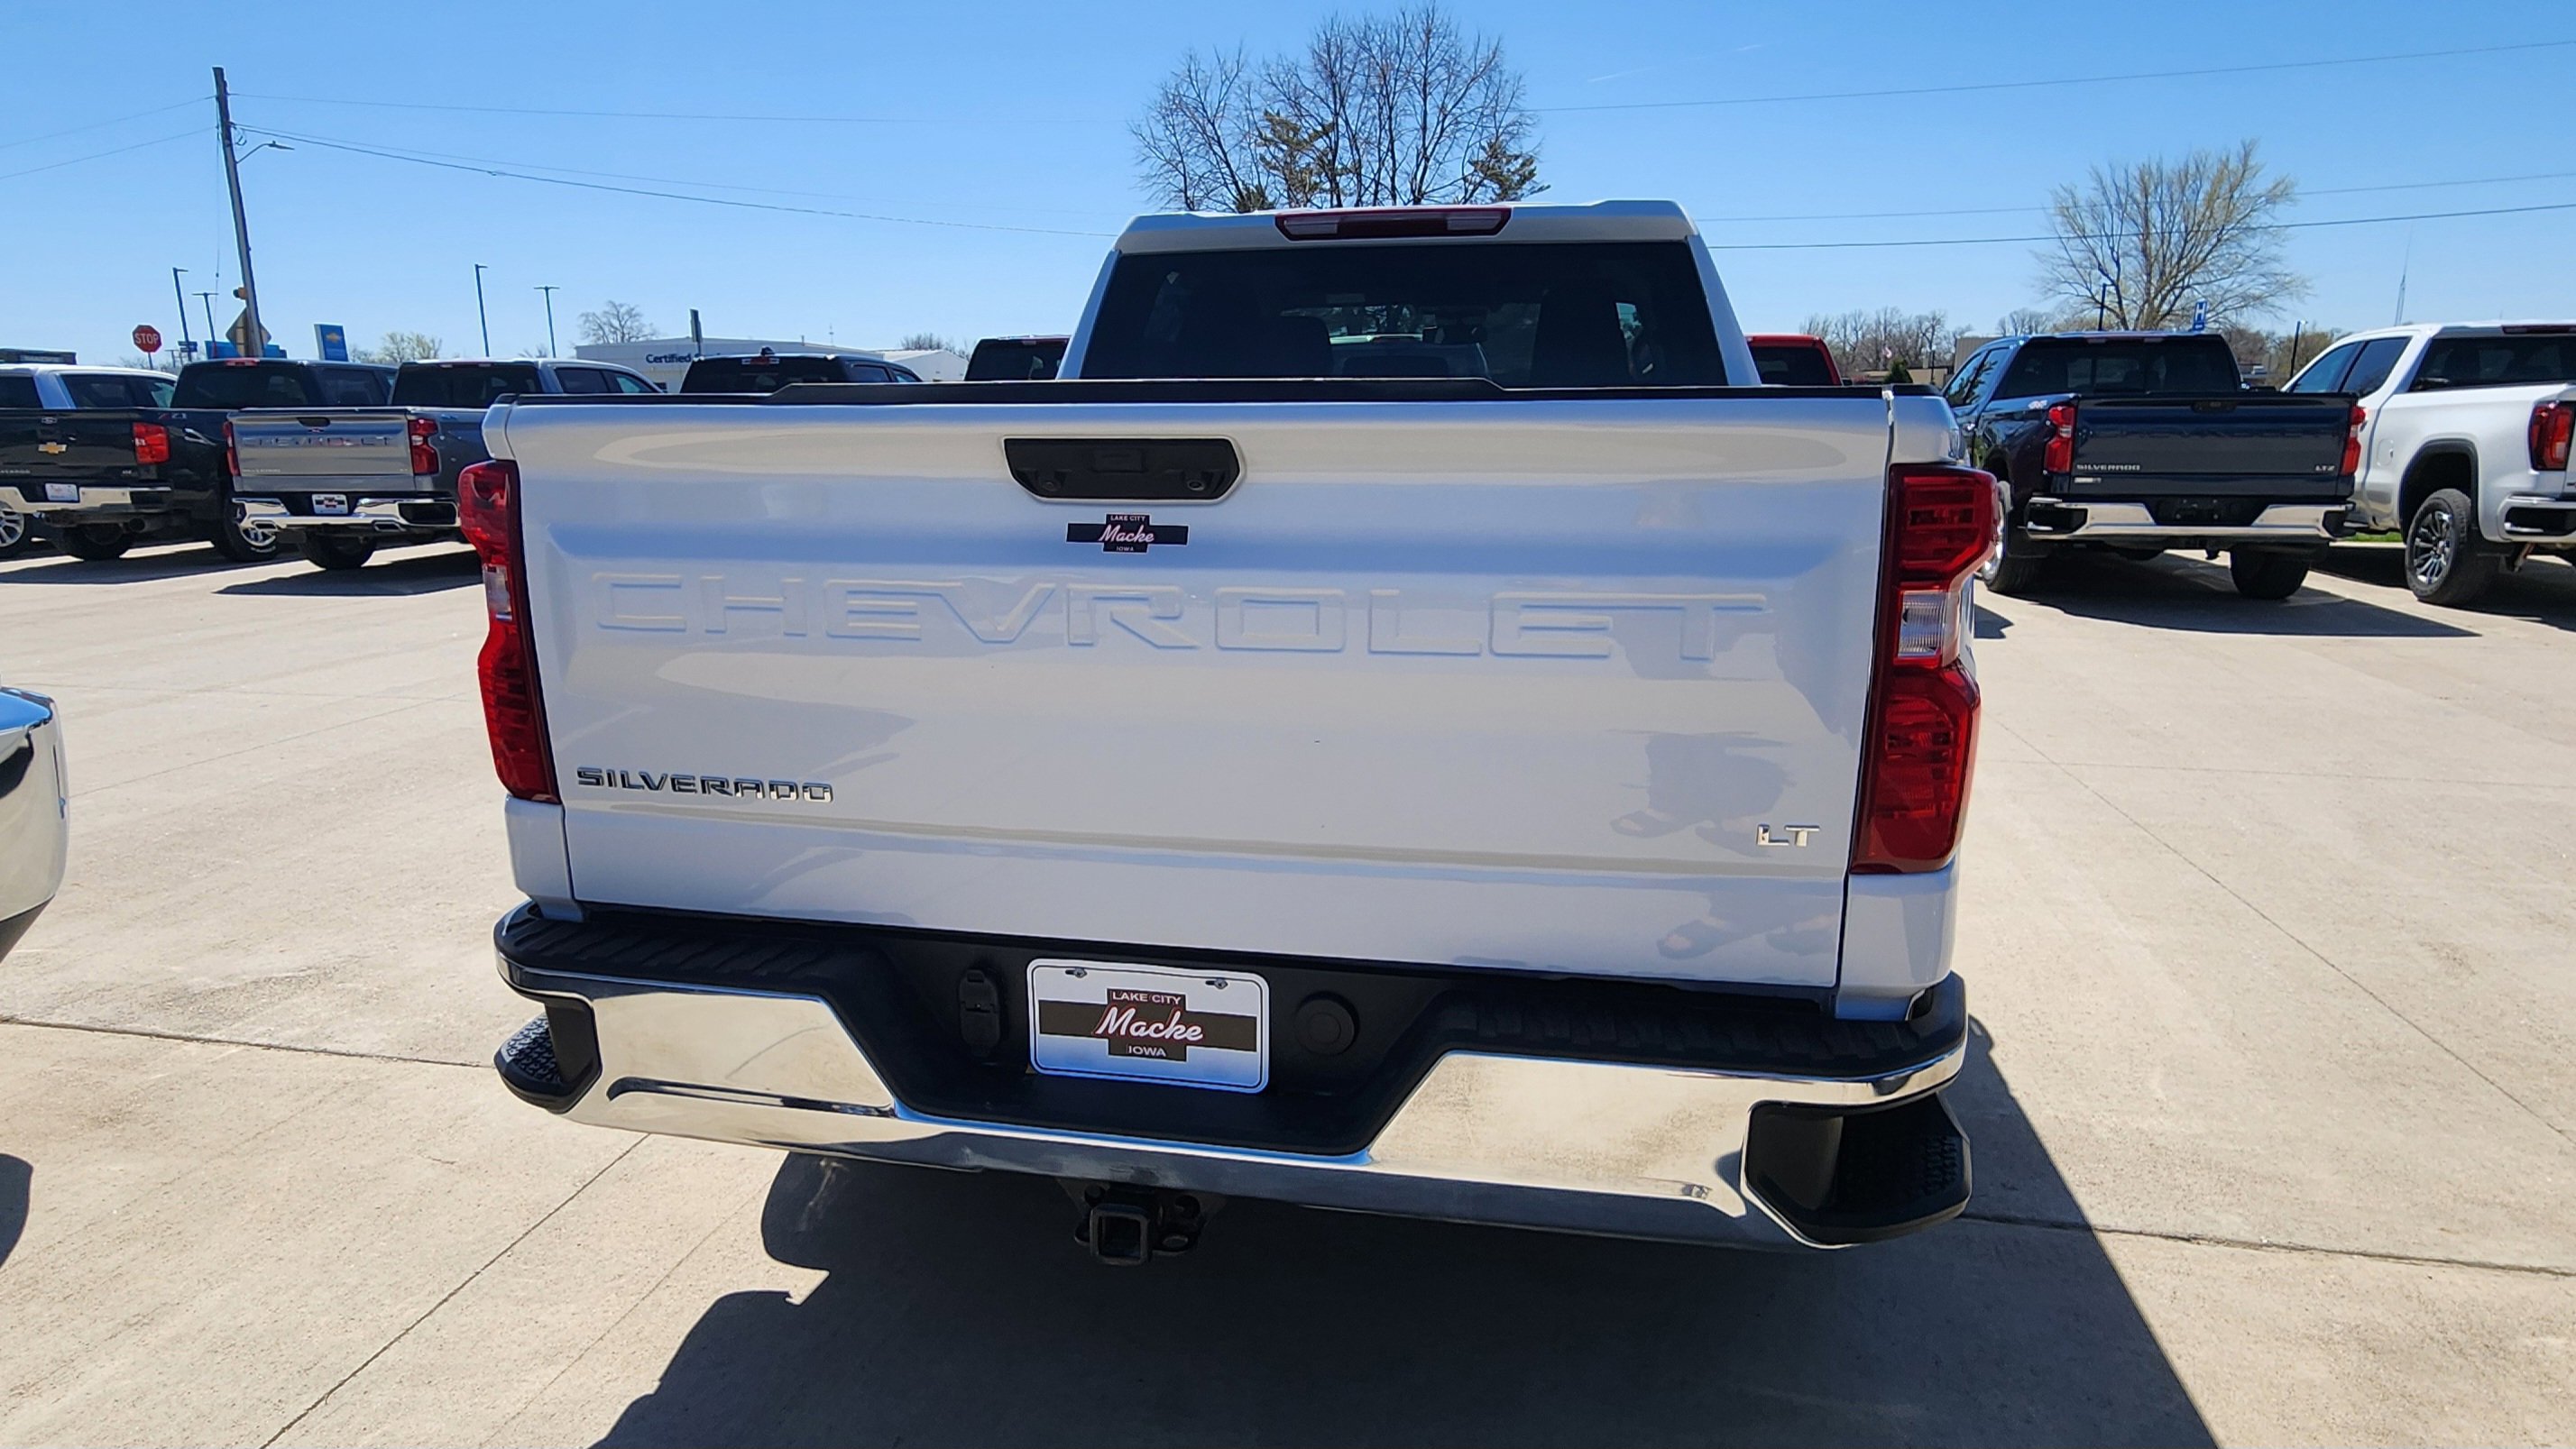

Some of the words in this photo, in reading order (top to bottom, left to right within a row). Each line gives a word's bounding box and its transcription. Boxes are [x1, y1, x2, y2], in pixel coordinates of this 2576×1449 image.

[134, 333, 159, 344] STOP
[646, 353, 691, 363] Certified
[2076, 463, 2140, 472] SILVERADO
[1098, 524, 1155, 543] Macke
[593, 573, 1766, 662] CHEVROLET
[576, 766, 833, 802] SILVERADO
[1756, 824, 1820, 847] LT
[1112, 991, 1148, 1003] LAKE
[1152, 994, 1182, 1005] CITY
[1093, 1006, 1204, 1042] Macke
[1127, 1044, 1167, 1057] IOWA
